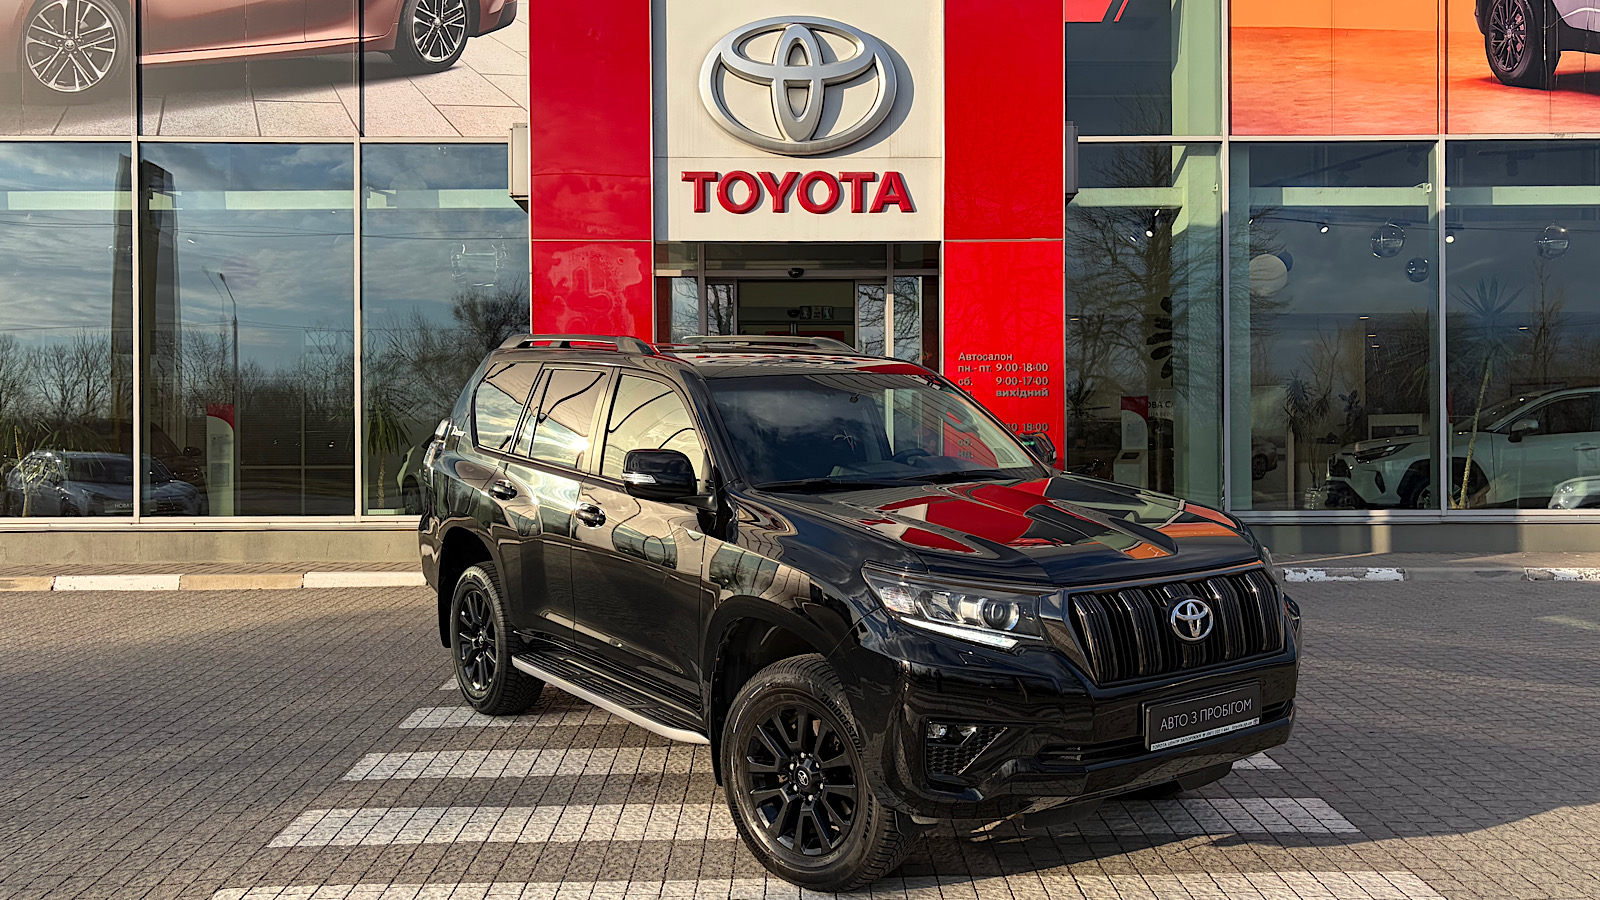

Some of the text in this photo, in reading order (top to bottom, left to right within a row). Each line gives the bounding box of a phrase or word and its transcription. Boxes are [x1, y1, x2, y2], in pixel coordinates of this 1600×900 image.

[681, 170, 916, 214] TOYOTA
[958, 352, 1014, 361] Автосалон
[958, 377, 974, 386] сб.
[996, 387, 1049, 398] вихідний
[957, 437, 973, 446] сб.
[1160, 698, 1252, 731] АВТО З ПРОБІГОМ
